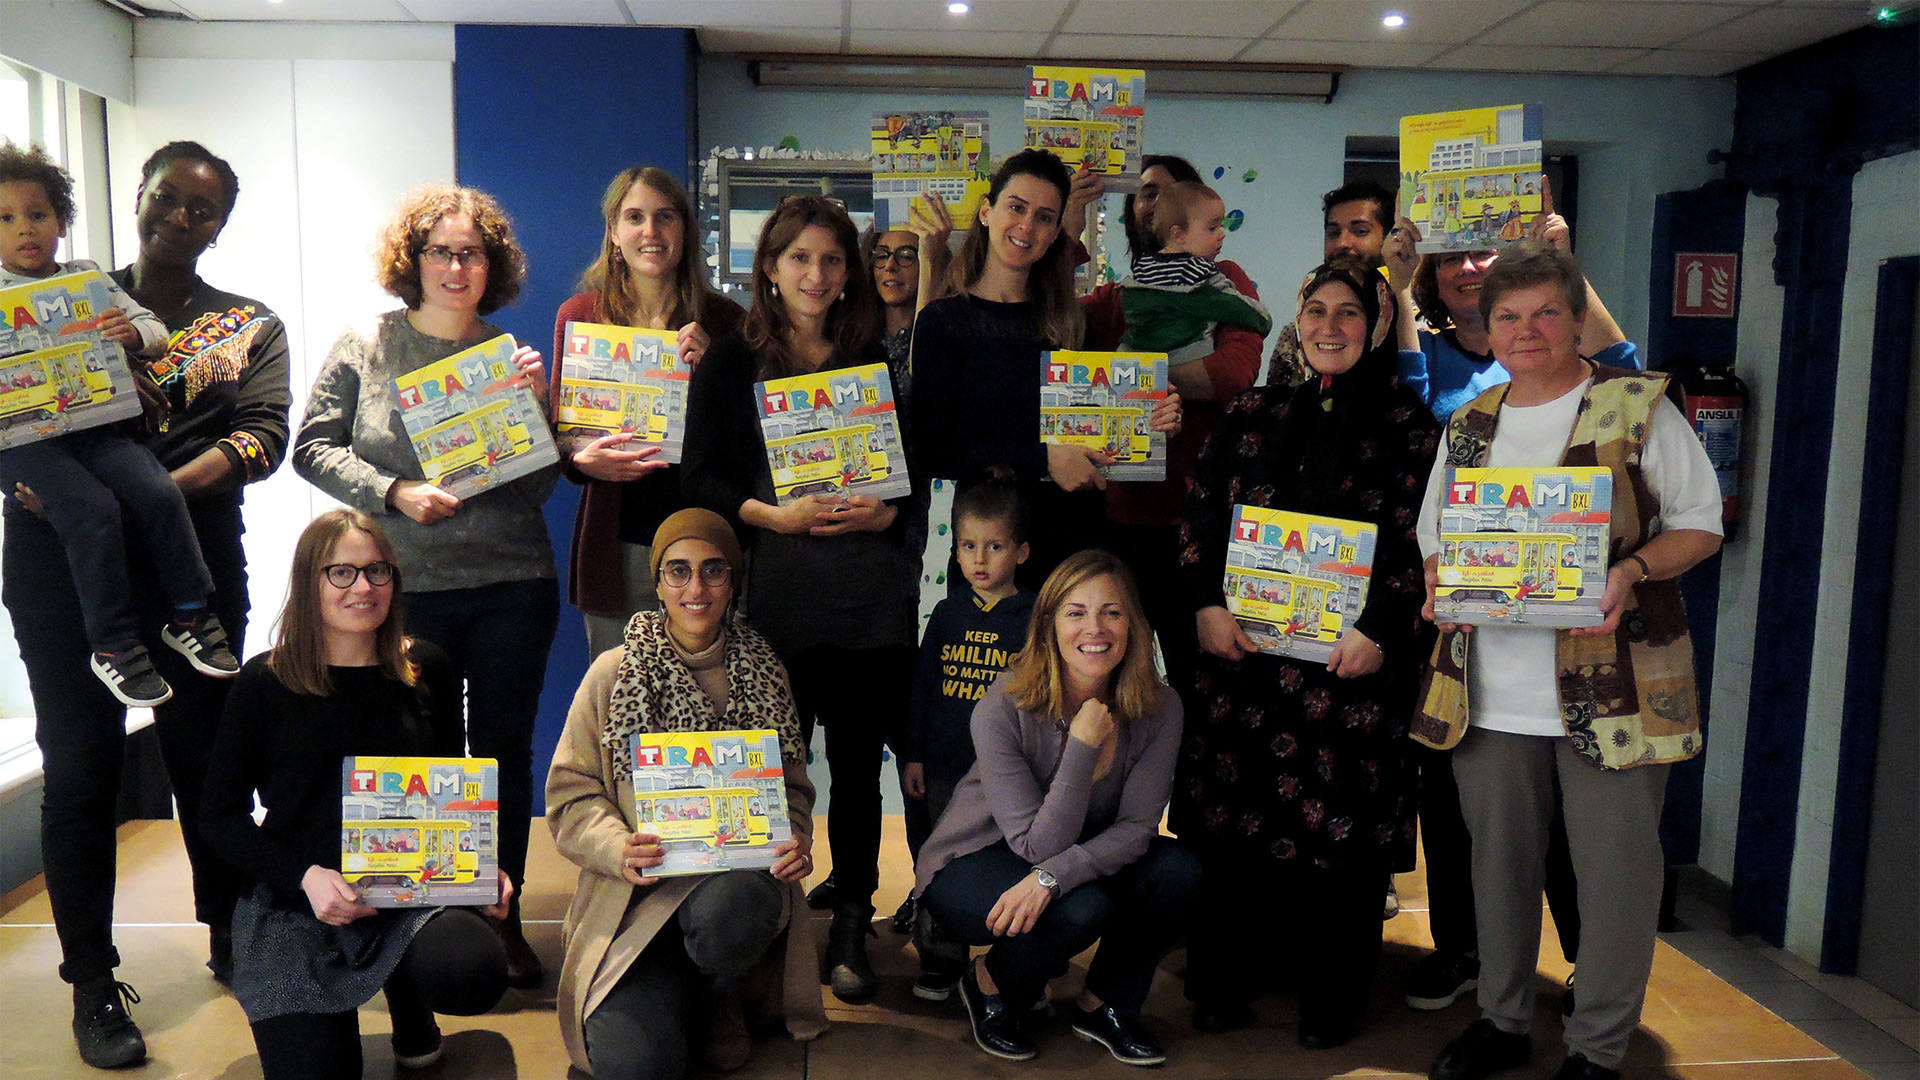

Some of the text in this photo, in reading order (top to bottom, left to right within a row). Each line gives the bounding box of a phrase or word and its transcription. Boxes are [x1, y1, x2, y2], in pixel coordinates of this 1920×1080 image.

[1032, 80, 1113, 102] TRAM
[74, 300, 91, 318] BXL
[571, 336, 659, 363] TRAM
[491, 362, 506, 378] BXL
[662, 354, 675, 368] BXL
[400, 360, 489, 406] TRAM
[1050, 365, 1136, 388] TRAM
[1140, 375, 1152, 388] BXL
[766, 382, 860, 411] TRAM
[863, 387, 878, 401] BXL
[1453, 483, 1567, 508] TRAM
[1572, 493, 1588, 509] BXL
[1239, 521, 1336, 555] TRAM
[1339, 545, 1354, 561] BXL
[964, 630, 999, 644] KEEP
[943, 664, 1003, 682] NO MATT
[942, 678, 991, 701] WHA
[640, 744, 743, 768] TRAM
[748, 752, 764, 767] BXL
[354, 771, 460, 796] TRAM
[465, 782, 480, 798] BXL
